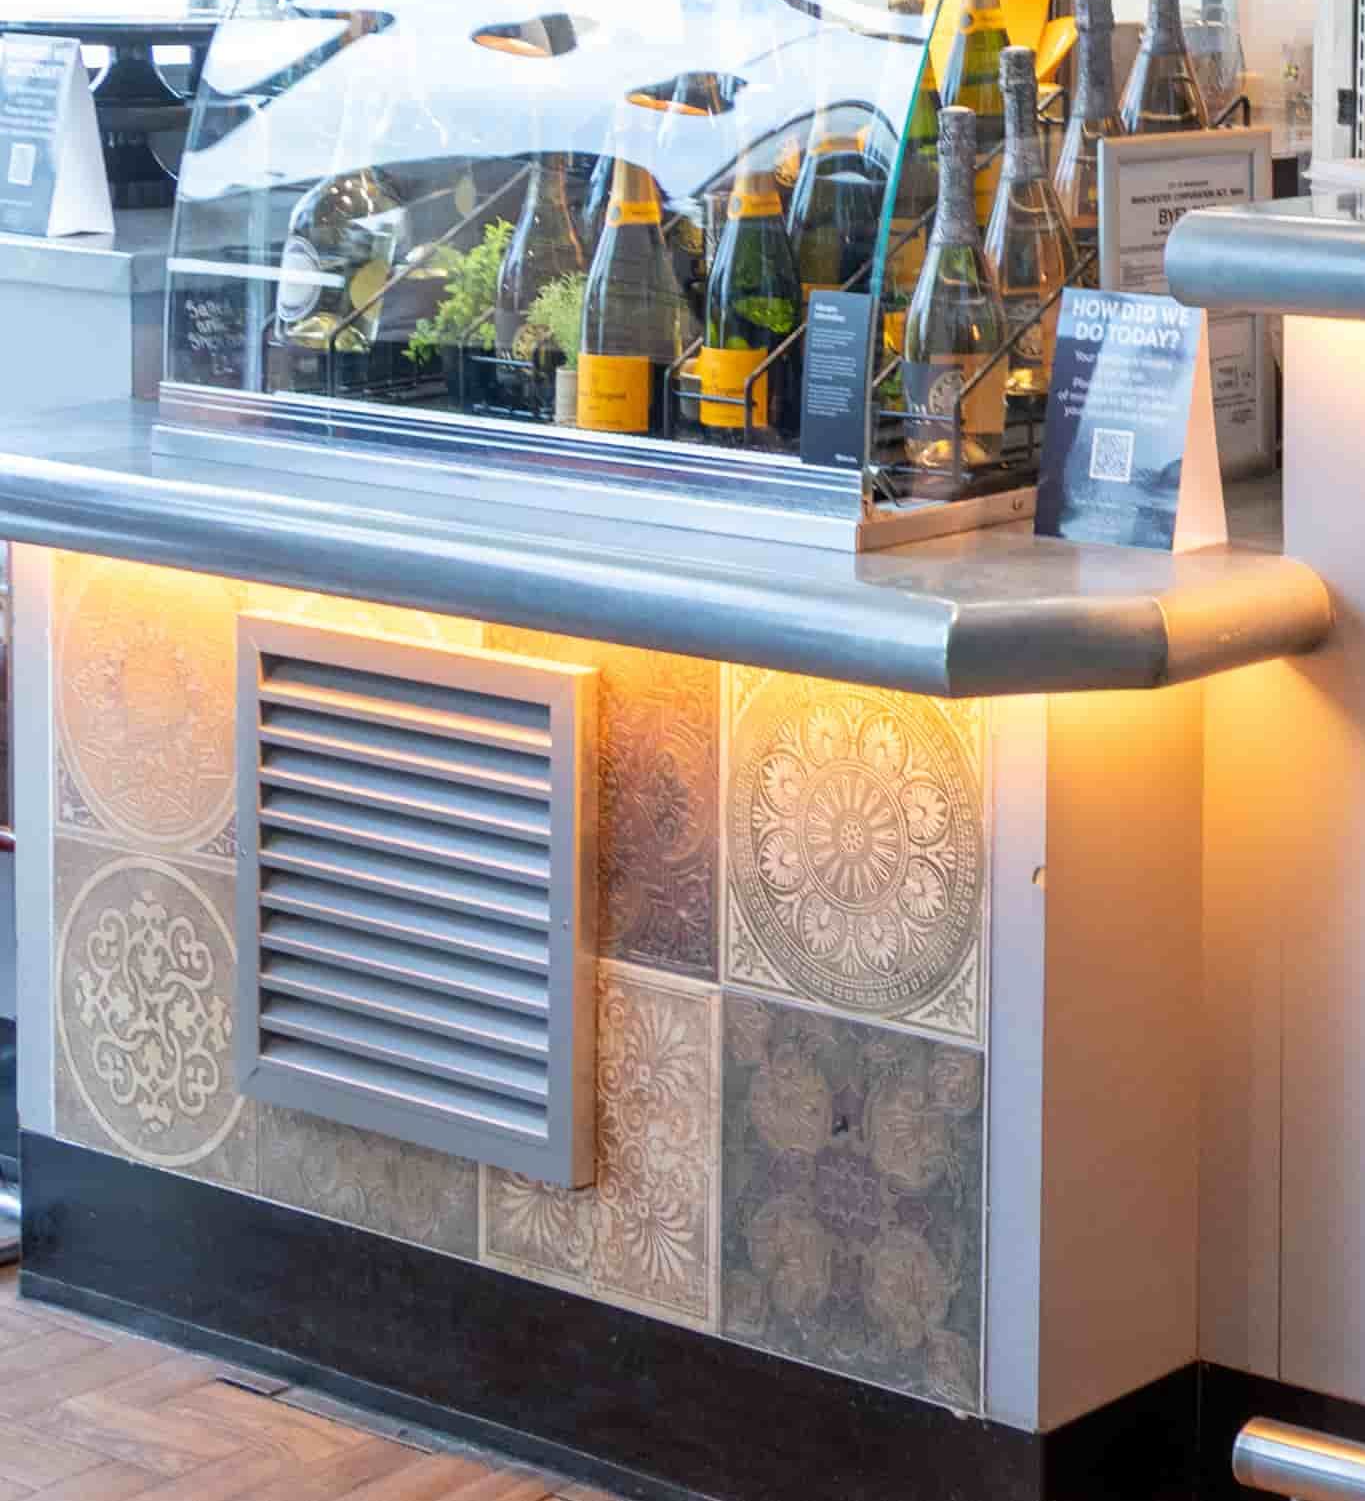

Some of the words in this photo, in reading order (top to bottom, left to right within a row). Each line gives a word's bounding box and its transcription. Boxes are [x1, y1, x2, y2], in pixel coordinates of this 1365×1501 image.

[1072, 298, 1119, 319] HOW
[1121, 302, 1157, 324] DID
[1163, 306, 1190, 326] WE
[1075, 322, 1104, 342] DO
[1108, 324, 1180, 349] TODAY?
